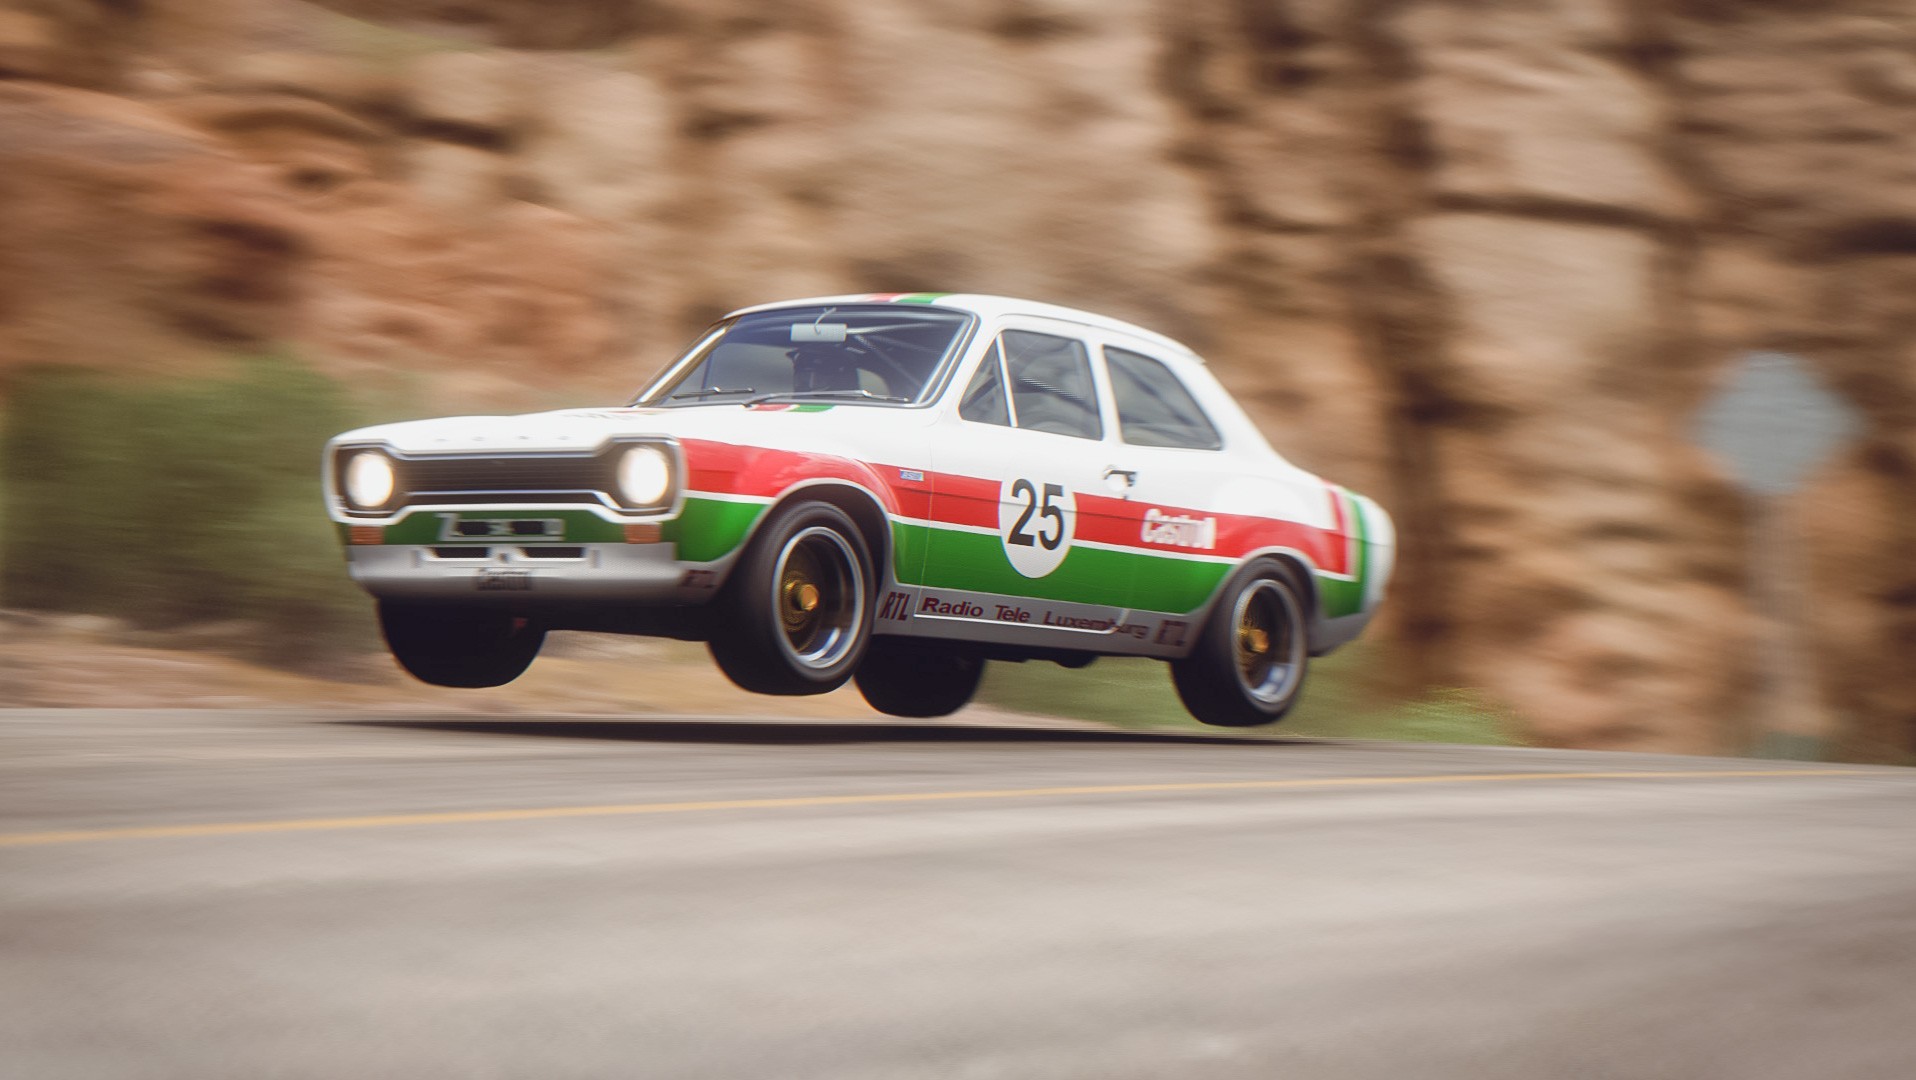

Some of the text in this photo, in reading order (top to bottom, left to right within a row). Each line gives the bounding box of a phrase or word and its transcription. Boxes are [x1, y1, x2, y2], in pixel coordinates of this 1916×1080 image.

[1007, 478, 1064, 551] 25
[879, 591, 911, 621] RTL
[921, 597, 984, 617] Radio
[995, 604, 1031, 623] Tele
